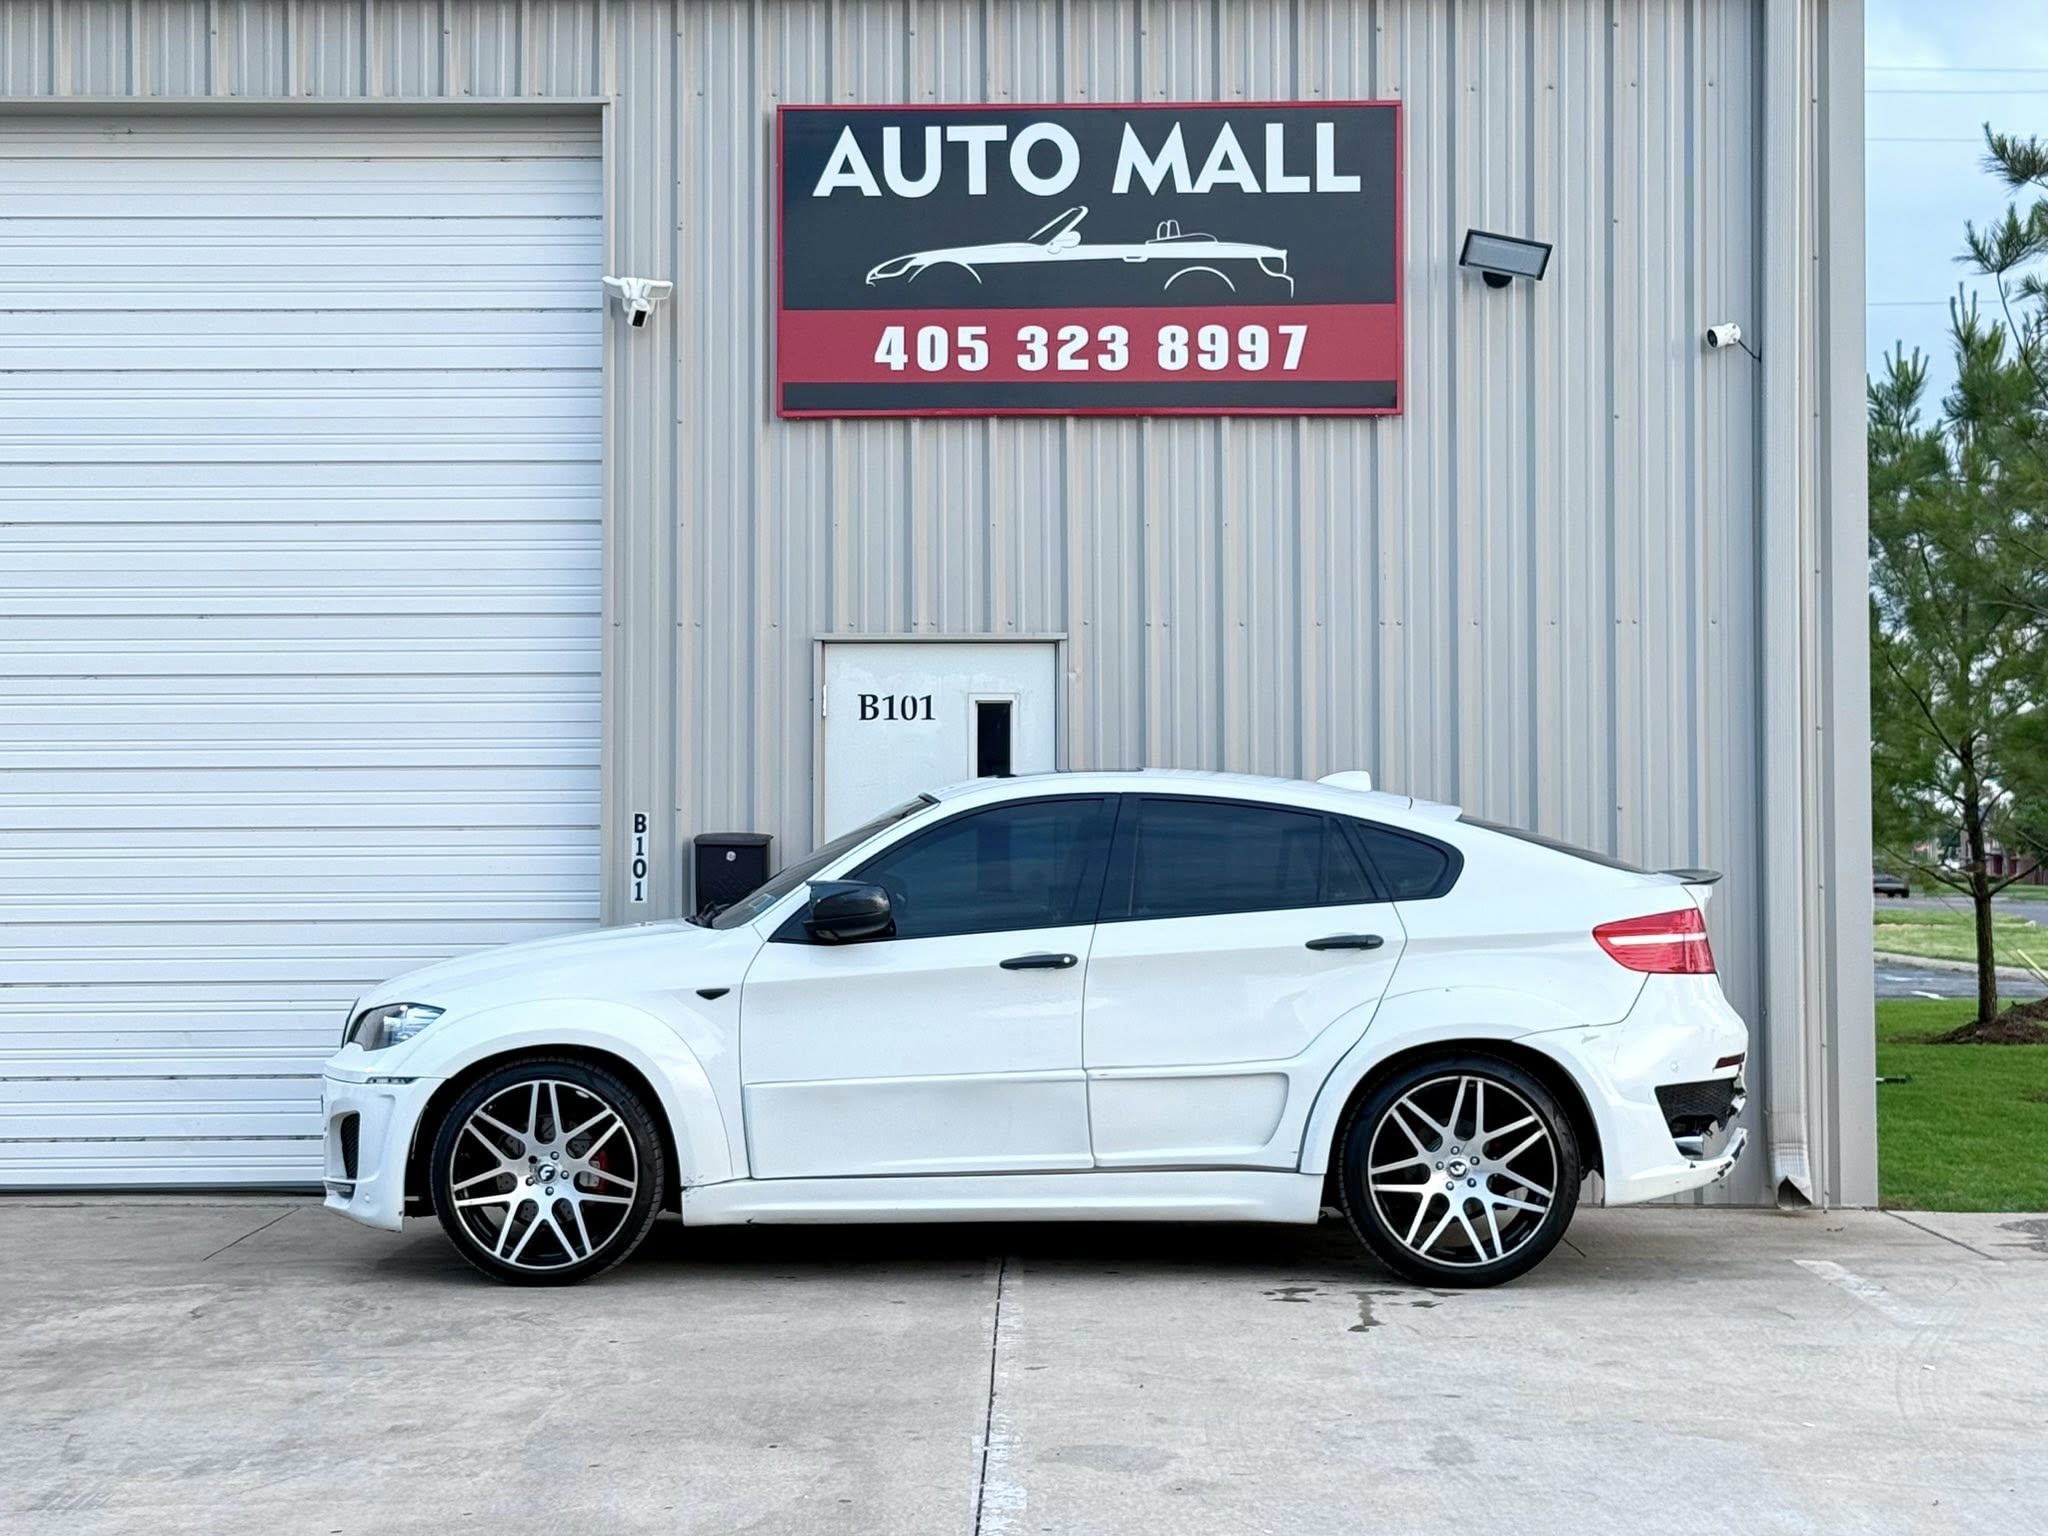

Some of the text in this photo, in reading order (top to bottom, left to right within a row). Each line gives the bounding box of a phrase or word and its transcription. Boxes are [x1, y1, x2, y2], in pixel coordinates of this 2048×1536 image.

[812, 121, 1361, 198] AUTO MALL
[874, 325, 1308, 371] 405 323 8997
[858, 693, 936, 721] B101
[633, 813, 648, 901] B101
